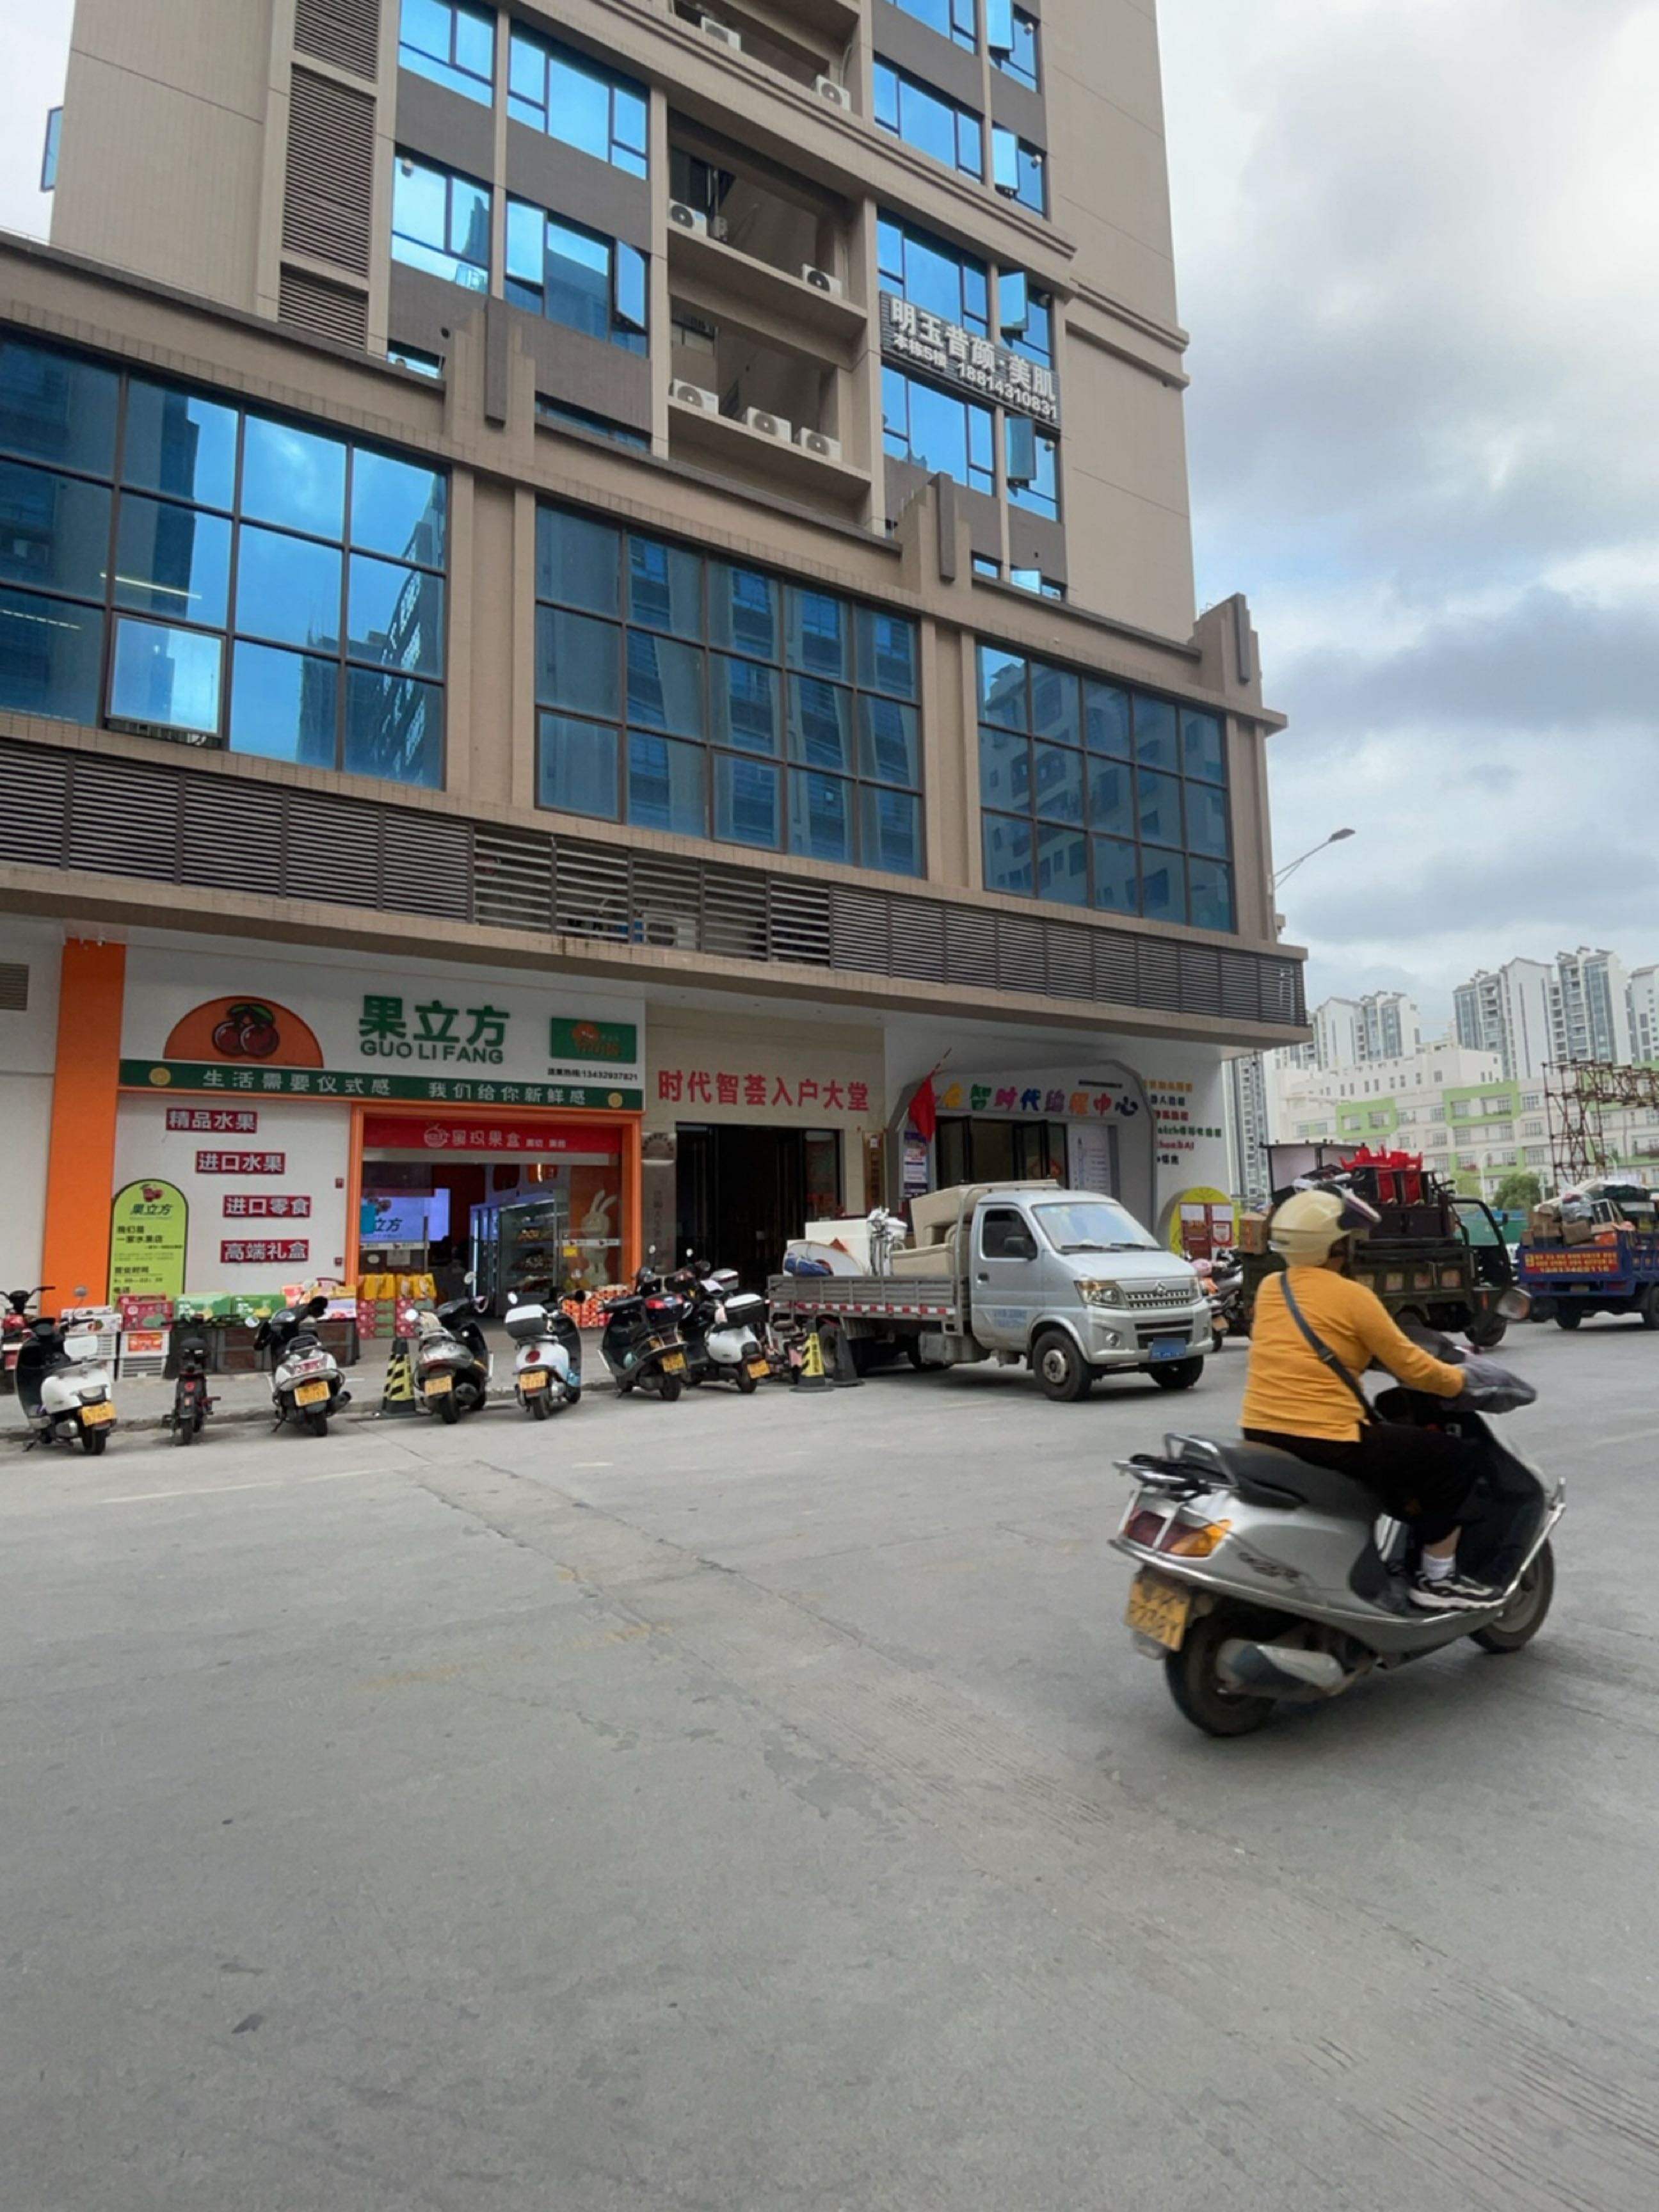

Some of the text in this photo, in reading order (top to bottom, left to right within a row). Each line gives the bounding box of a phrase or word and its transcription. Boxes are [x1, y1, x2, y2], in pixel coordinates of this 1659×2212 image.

[958, 362, 1056, 419] 18814310831
[359, 995, 510, 1047] 果立方
[203, 1069, 586, 1105] 生活需要仪式感 我们给你新鲜感
[658, 1070, 870, 1112] 时代智荟入户大堂
[169, 1110, 255, 1131] 精品水果
[199, 1153, 283, 1172] 进口水果
[225, 1196, 310, 1215] 进口零食
[374, 1217, 403, 1232] 立方
[224, 1242, 308, 1261] 高端礼盒
